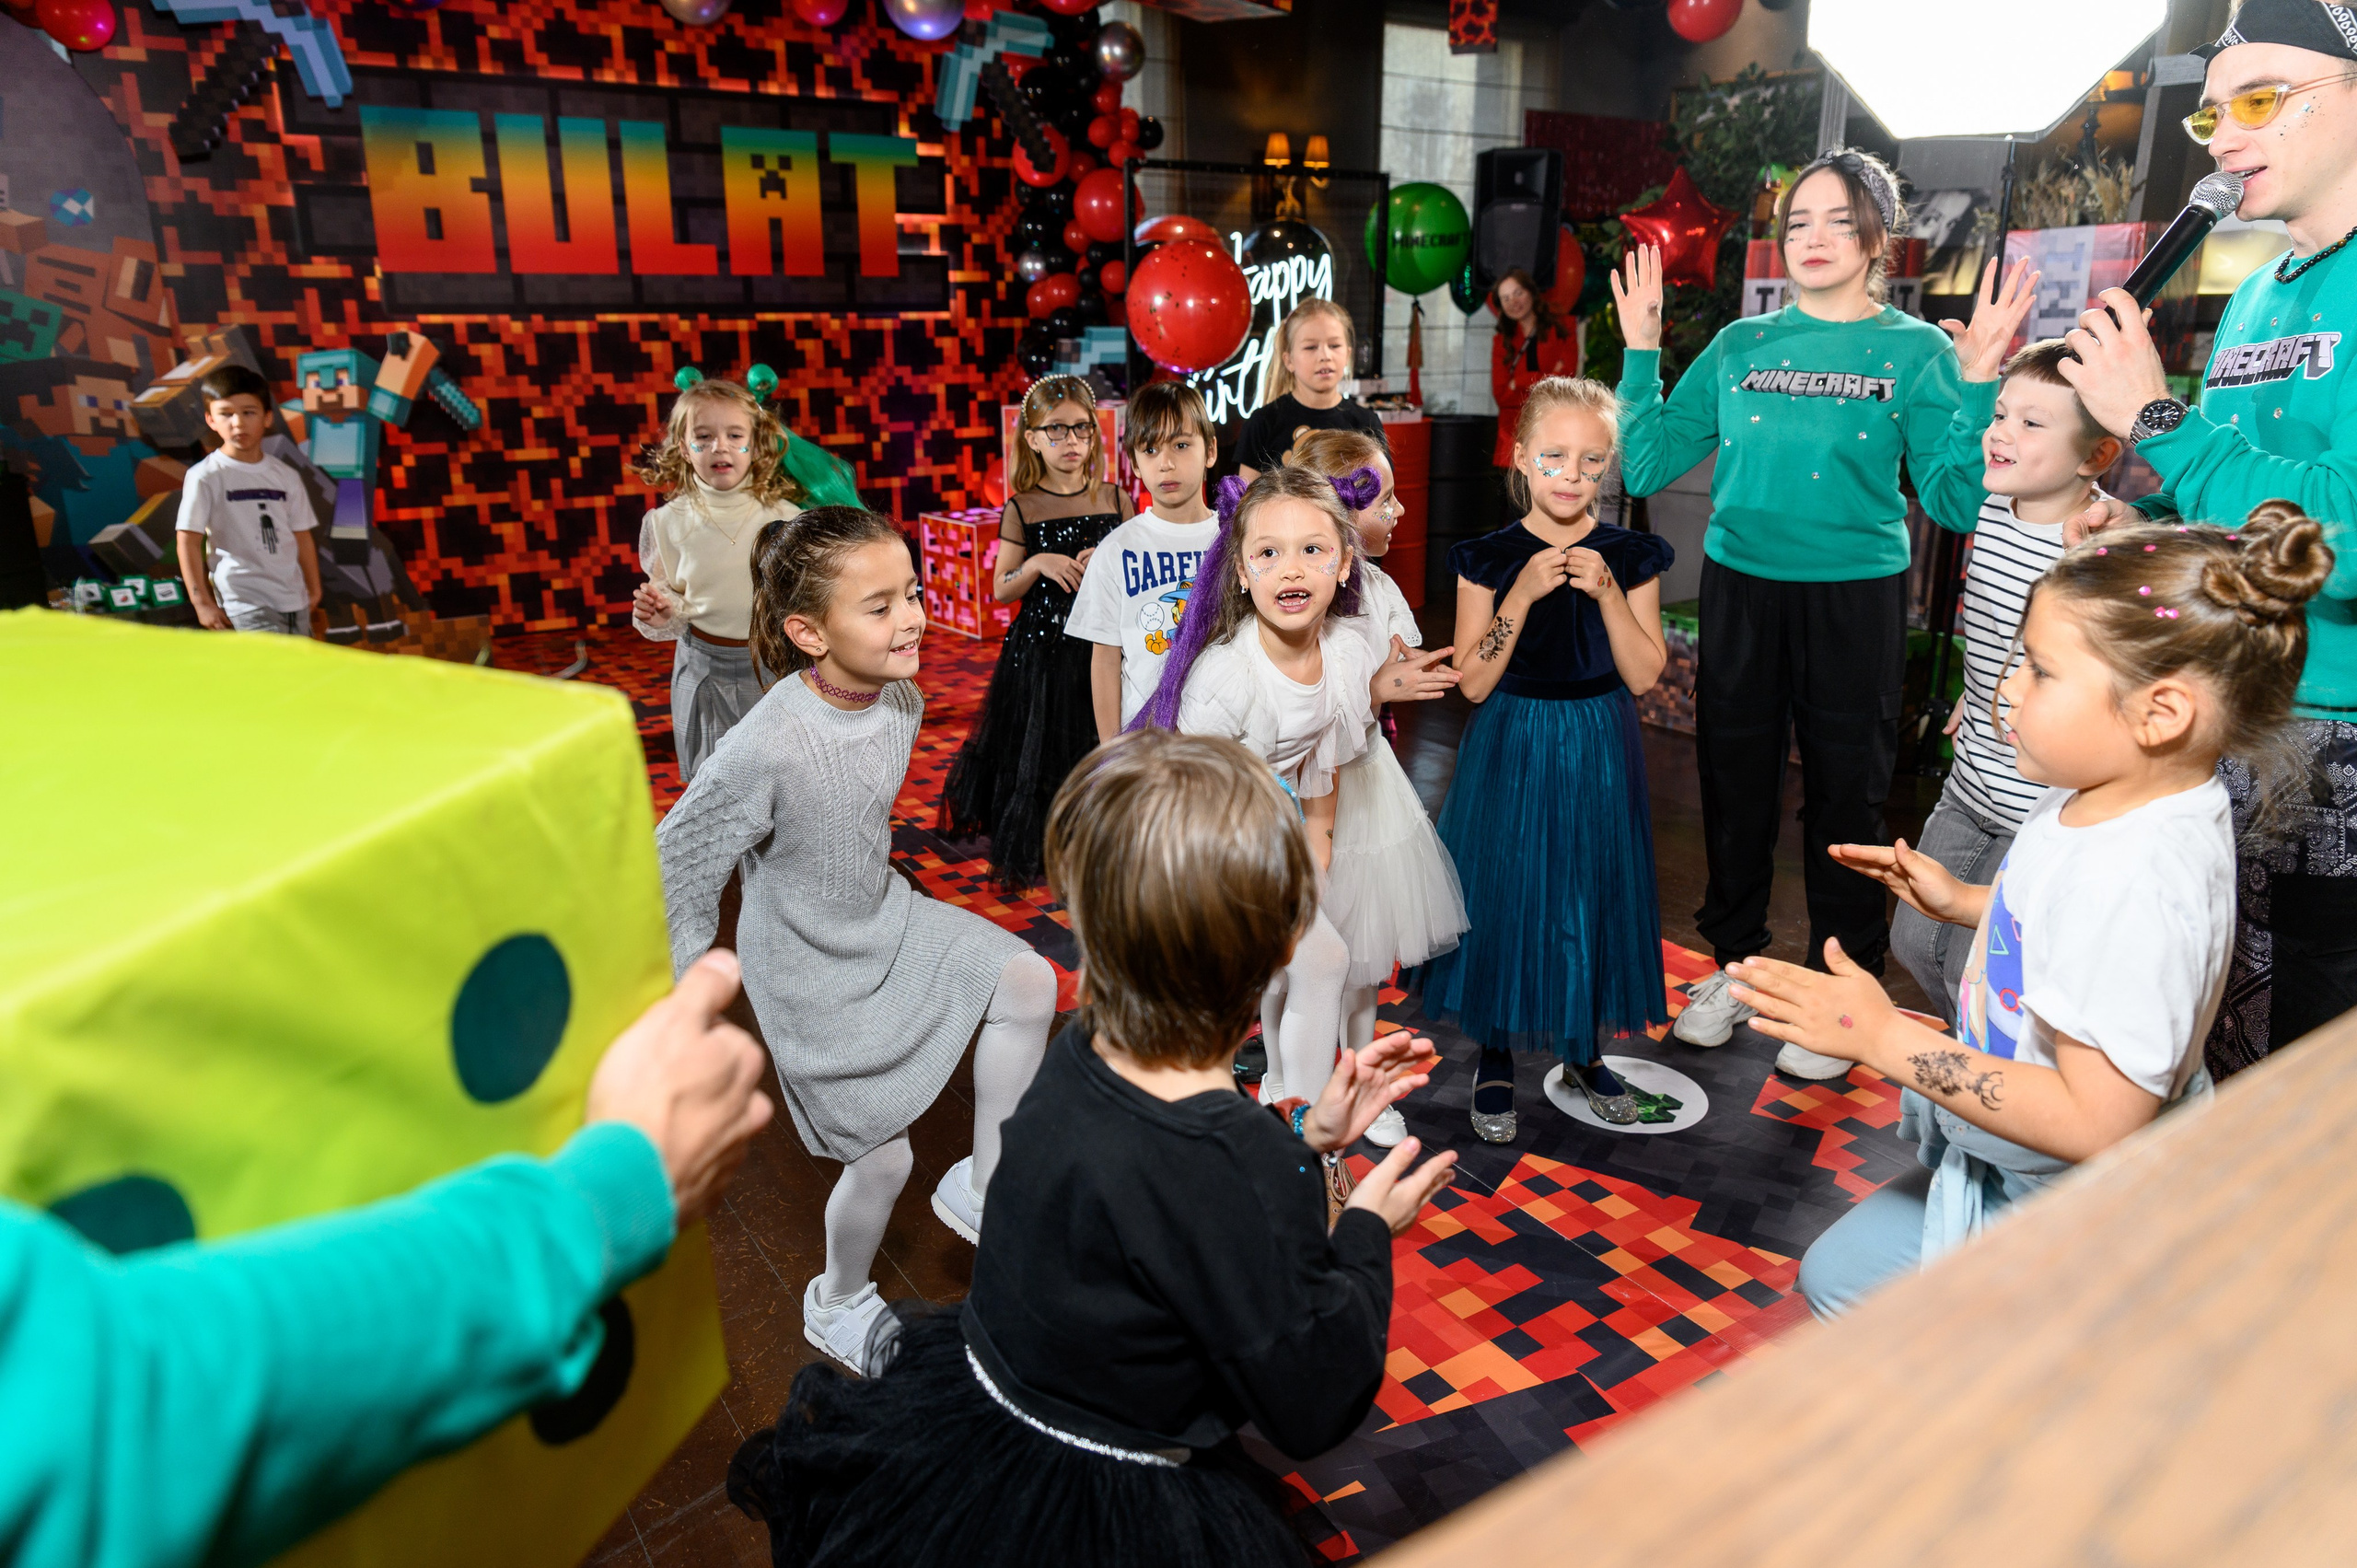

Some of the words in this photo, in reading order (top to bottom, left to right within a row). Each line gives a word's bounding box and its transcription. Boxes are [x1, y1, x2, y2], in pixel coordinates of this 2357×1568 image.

[359, 105, 919, 276] BULAT
[1230, 231, 1333, 328] appy
[1739, 369, 1897, 402] MINECRAFT
